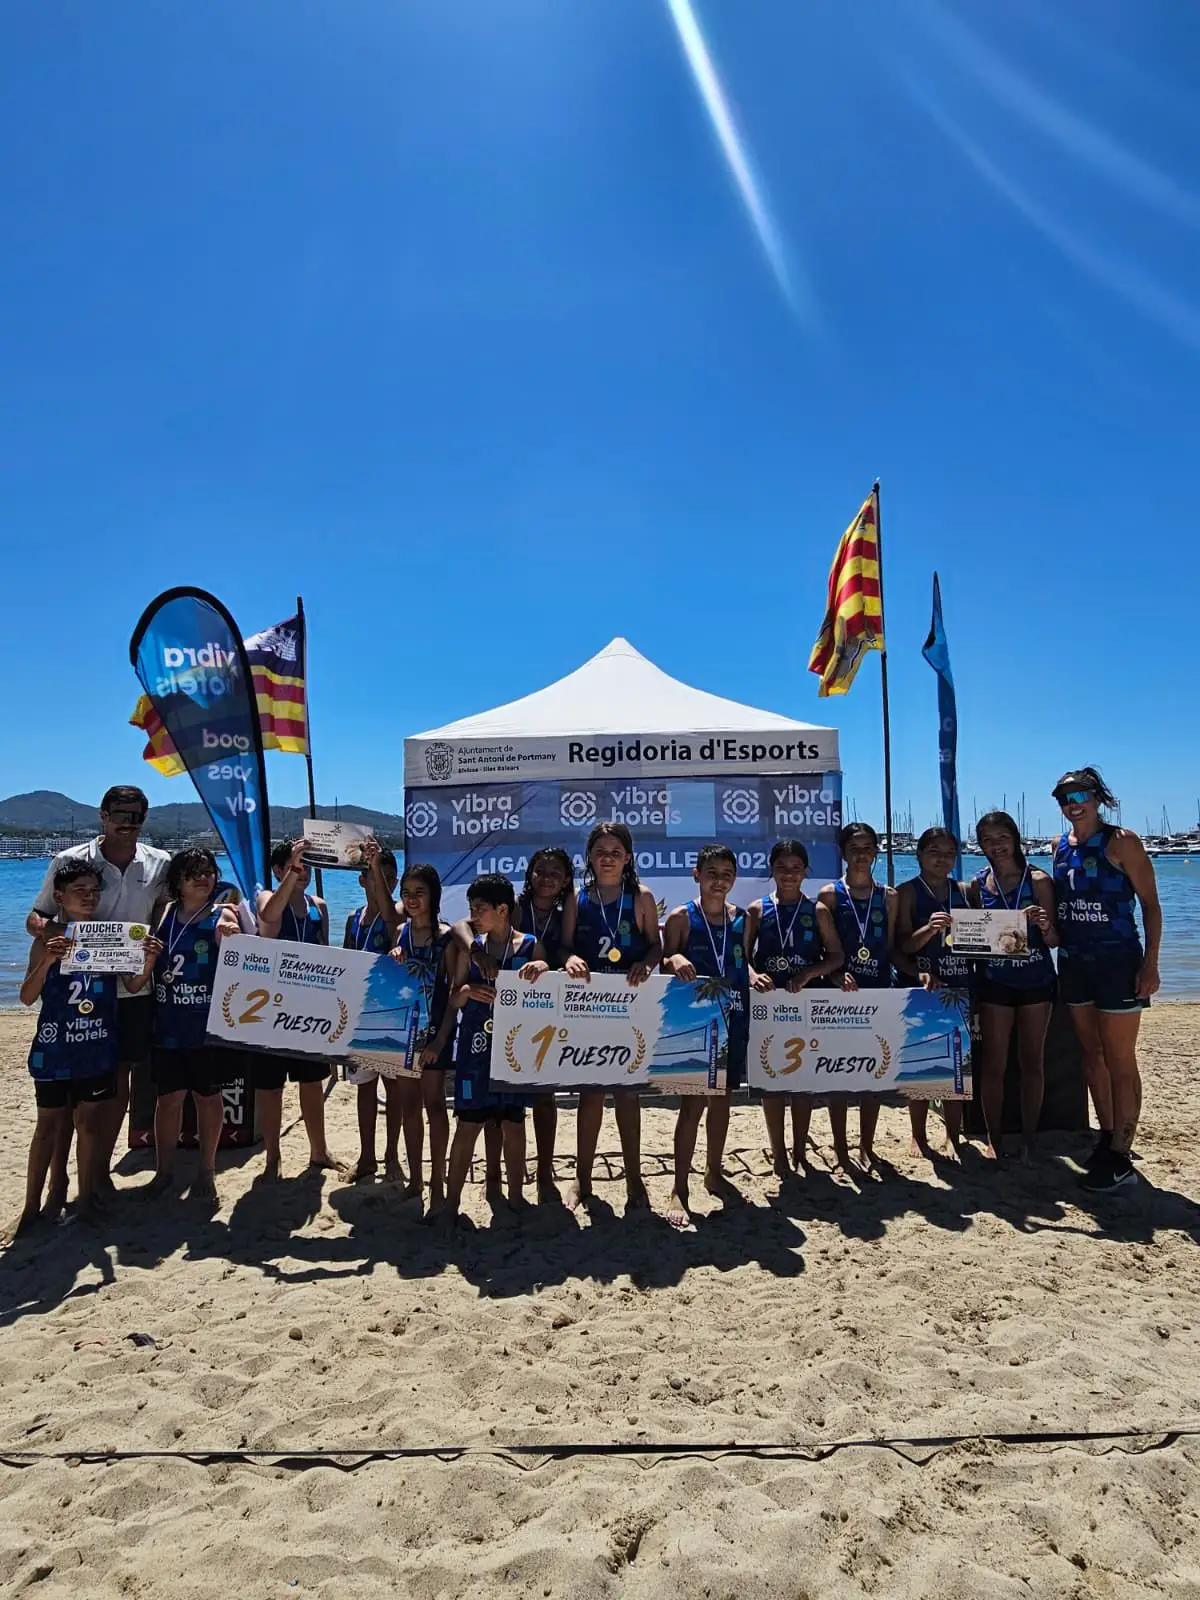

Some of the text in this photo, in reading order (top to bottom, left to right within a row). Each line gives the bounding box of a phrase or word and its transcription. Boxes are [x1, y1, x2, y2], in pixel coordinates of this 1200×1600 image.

[458, 745, 514, 755] Ajuntament de
[568, 738, 820, 767] Regidoria d'Esports
[458, 752, 556, 765] Sant Antoni de Portmany
[610, 786, 672, 805] vibra
[772, 784, 834, 804] vibra
[451, 793, 512, 813] vibra
[611, 805, 682, 826] hotels
[774, 805, 841, 826] hotels
[452, 812, 520, 835] hotels
[476, 855, 529, 875] LIGA
[1067, 868, 1076, 891] 1
[1069, 898, 1102, 911] vibra
[1071, 910, 1110, 922] hotels
[79, 923, 124, 933] VOUCHER
[597, 935, 612, 959] 2
[172, 953, 185, 976] 2
[244, 953, 269, 964] vibra
[242, 962, 271, 973] hotels
[280, 959, 346, 978] BEACHVOLLEY
[279, 970, 335, 985] VIBRAHOTELS
[67, 980, 83, 1005] 2
[172, 983, 207, 994] vibra
[522, 989, 551, 999] vibra
[172, 993, 212, 1005] hotels
[522, 999, 554, 1009] hotels
[564, 990, 638, 1004] BEACHVOLLEY
[563, 1003, 628, 1013] VIBRAHOTELS
[772, 1004, 799, 1013] vibra
[811, 1005, 879, 1017] BEACHVOLLEY
[66, 1017, 103, 1031] vibra
[273, 1012, 332, 1035] PUESTO
[772, 1013, 802, 1022] hotels
[810, 1016, 870, 1024] VIBRAHOTELS
[65, 1028, 108, 1043] hotels
[558, 1045, 631, 1067] PUESTO
[815, 1056, 876, 1074] PUESTO
